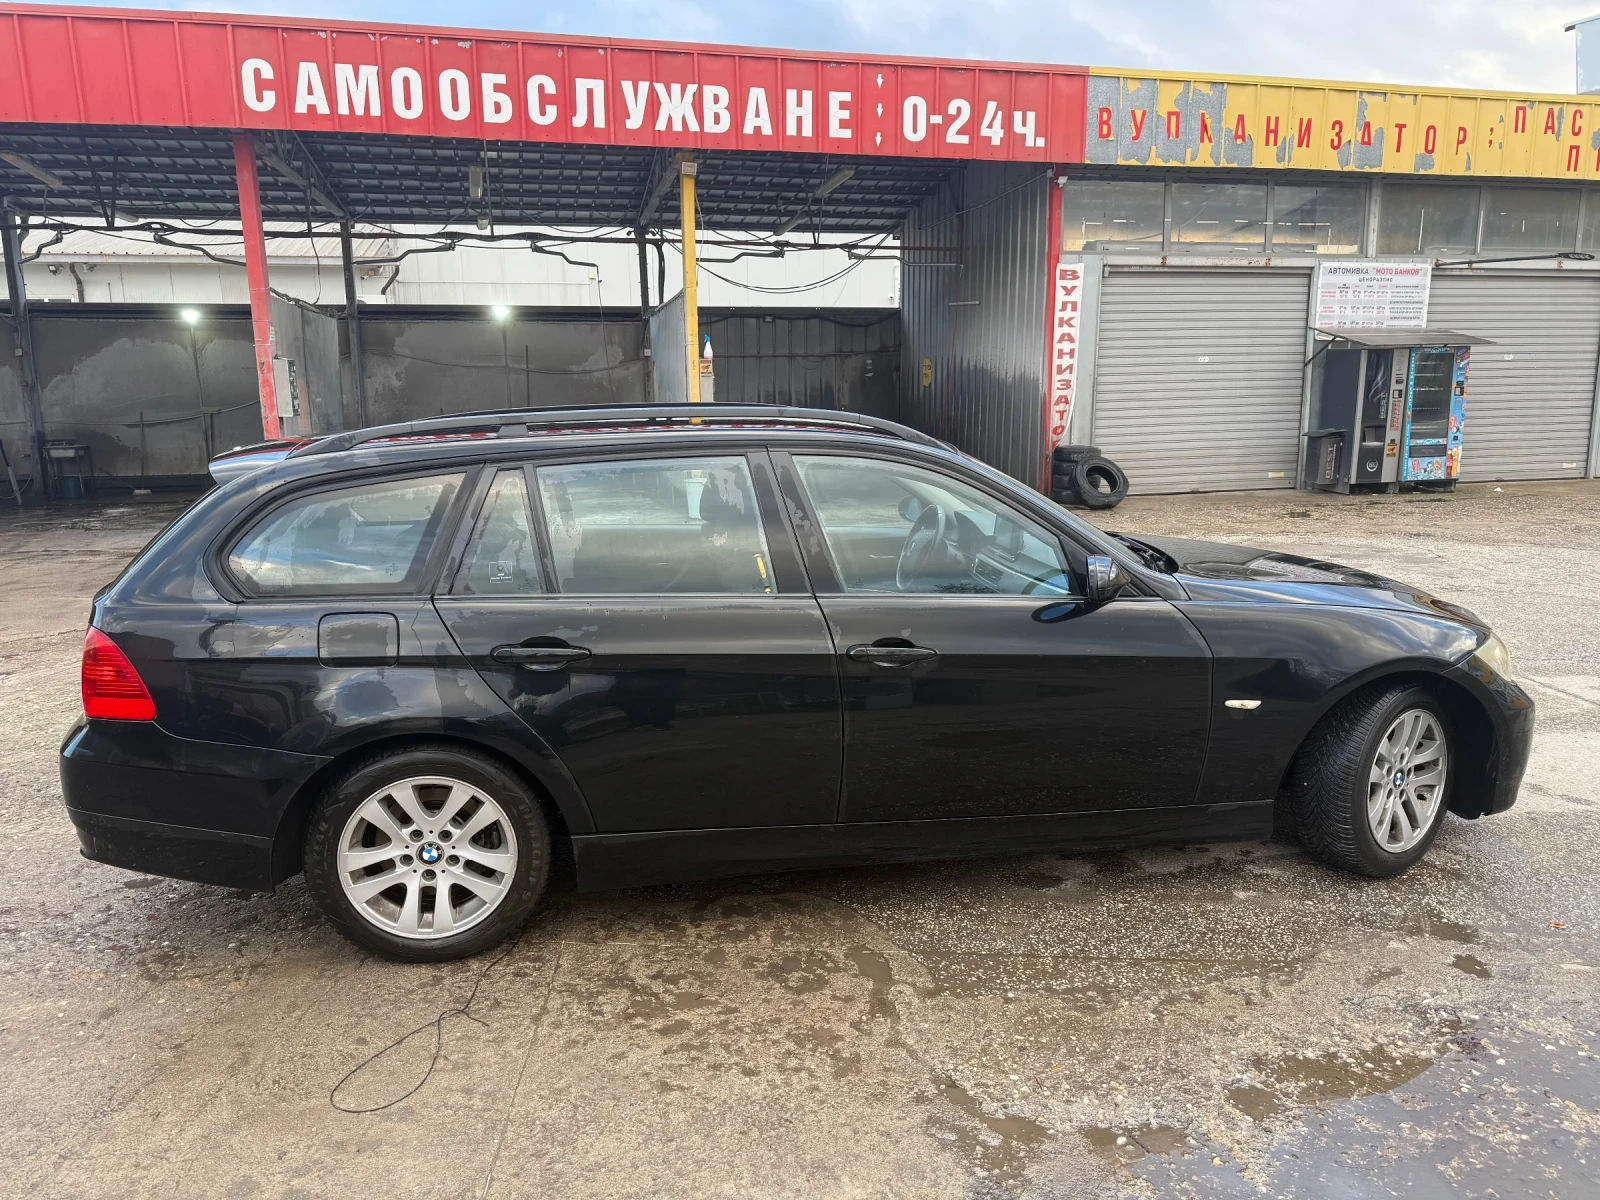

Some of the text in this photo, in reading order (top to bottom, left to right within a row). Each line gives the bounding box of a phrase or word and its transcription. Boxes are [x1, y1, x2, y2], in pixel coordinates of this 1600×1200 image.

[241, 58, 1046, 147] САМООБСЛУЖВАНЕ 0-24ч.
[1327, 267, 1369, 275] АВТОМИВКА
